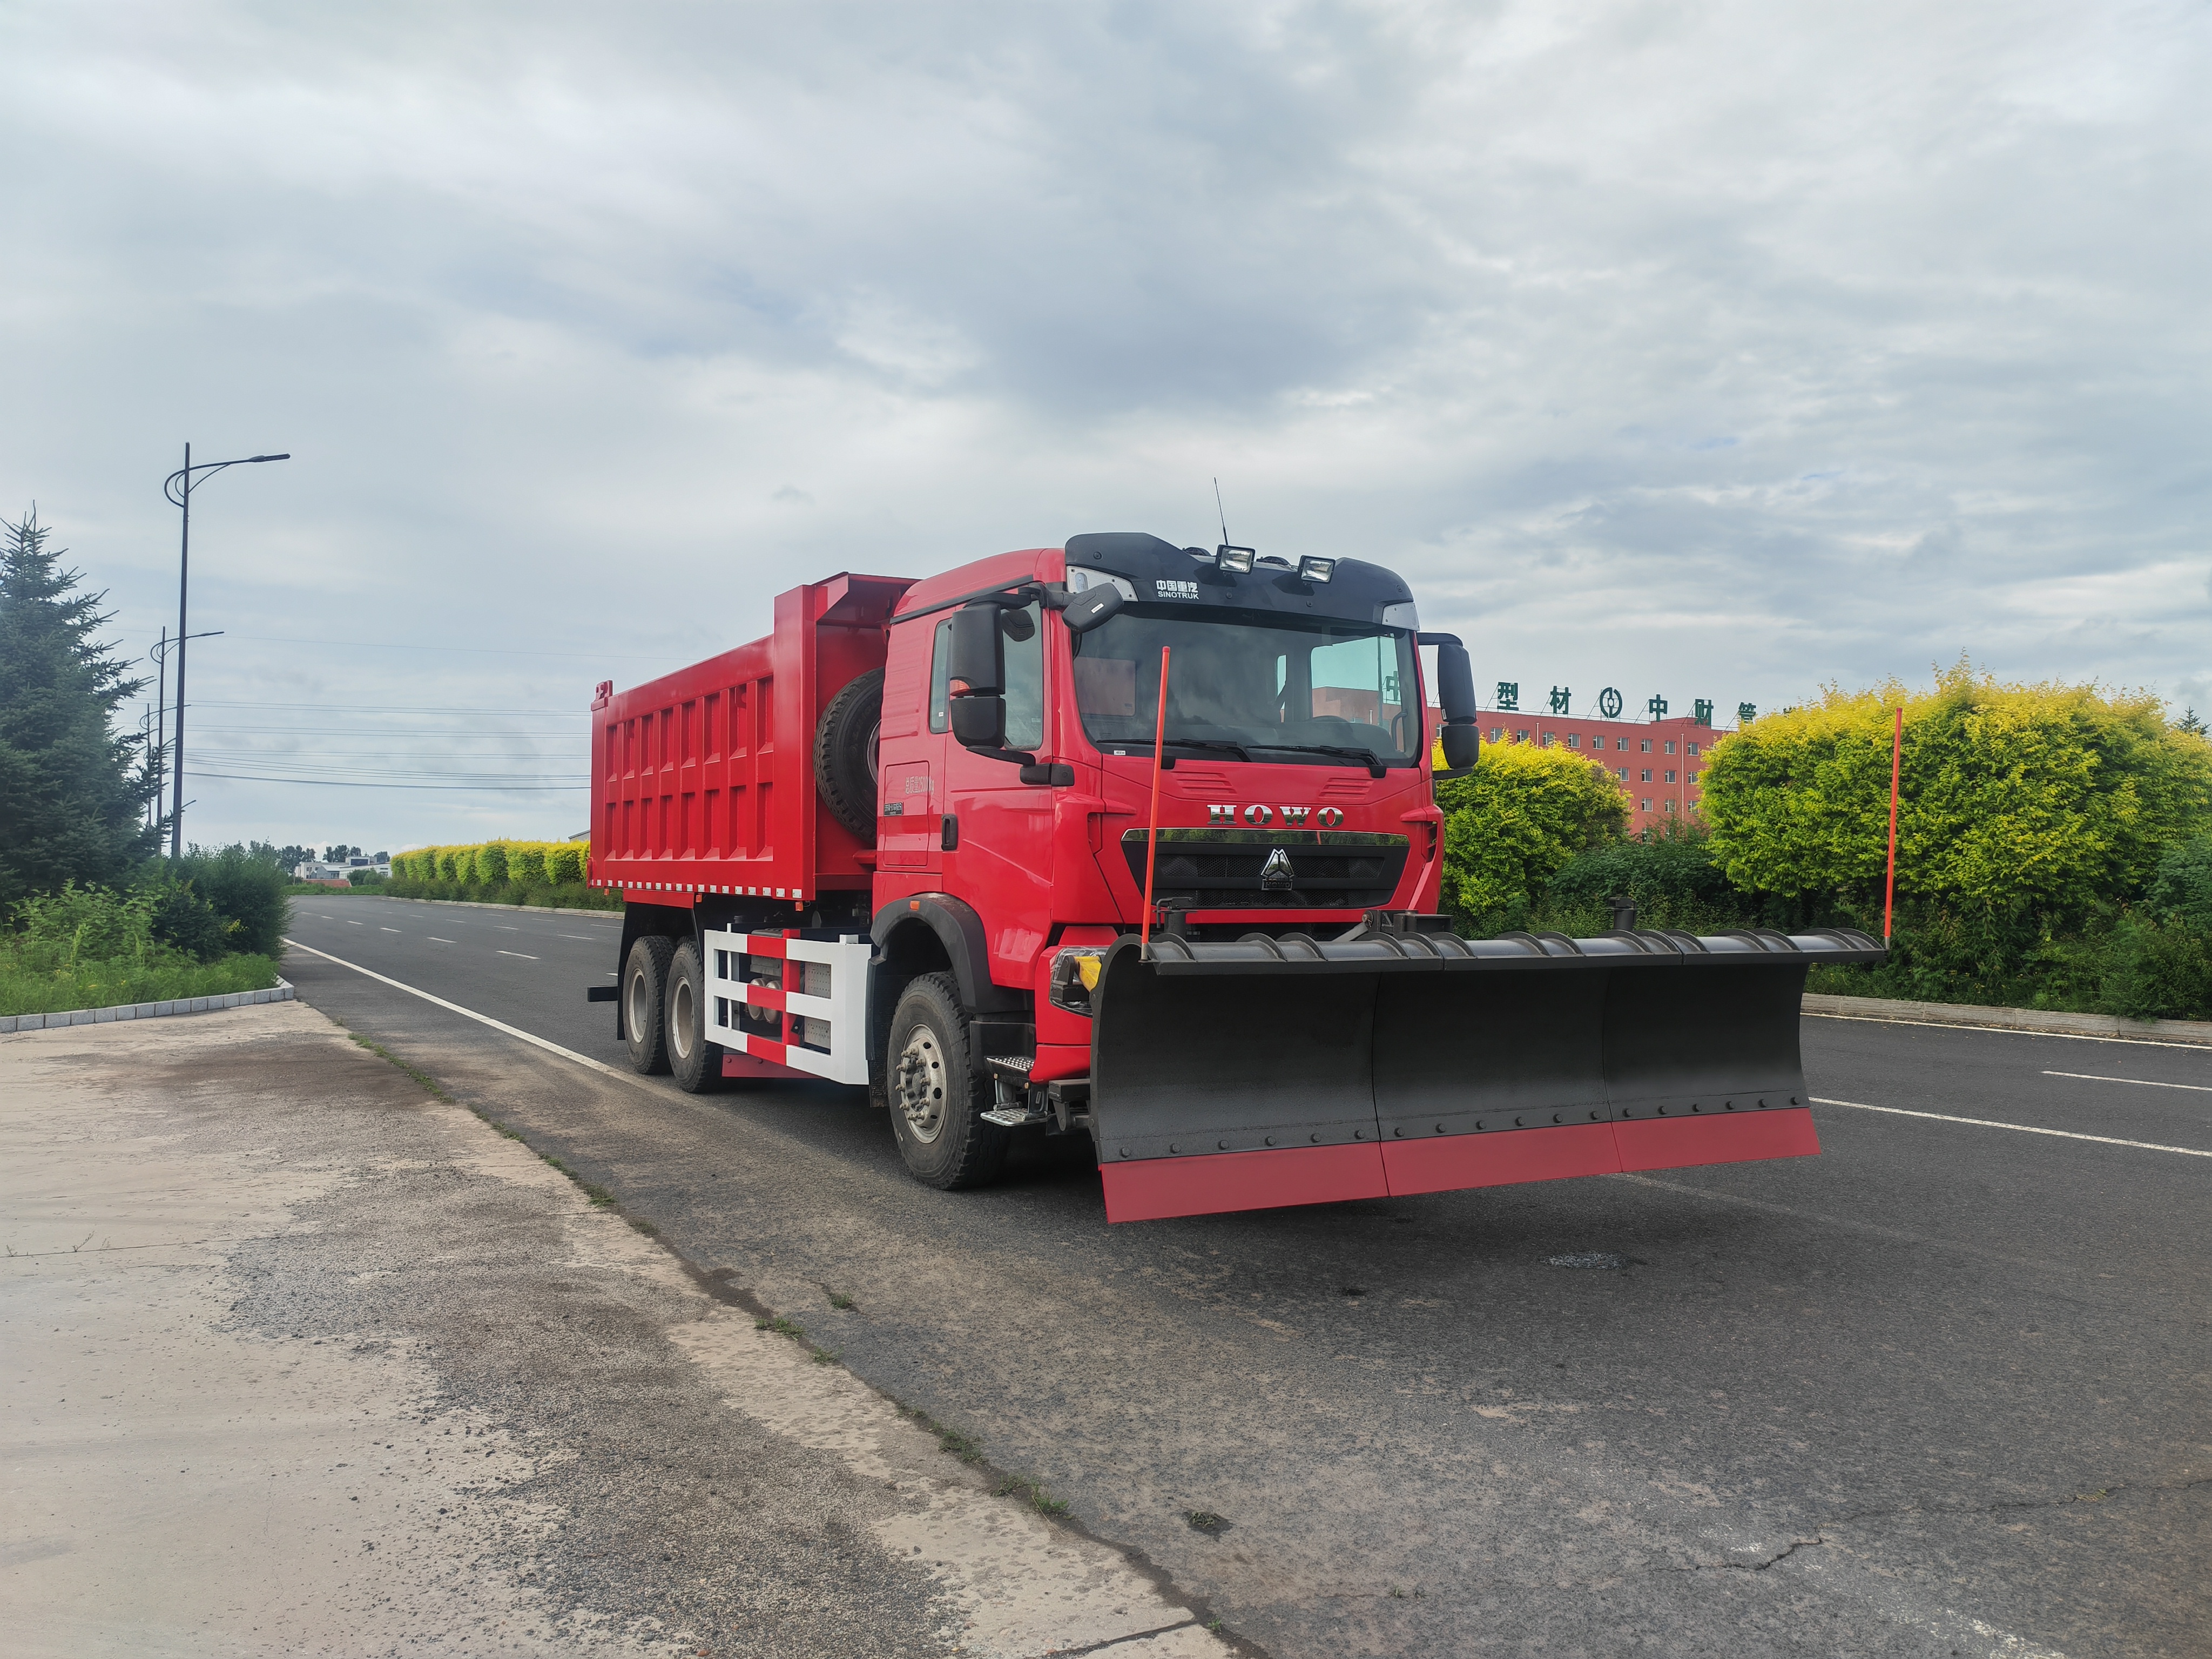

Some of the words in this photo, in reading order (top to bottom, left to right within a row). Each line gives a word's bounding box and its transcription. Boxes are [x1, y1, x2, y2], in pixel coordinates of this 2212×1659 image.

[1156, 579, 1198, 592] 中国重汽
[1158, 591, 1199, 599] SINOTRUK
[1649, 694, 1796, 730] 中财管
[905, 775, 934, 795] 总质量2500kg
[1207, 805, 1344, 827] HOWO
